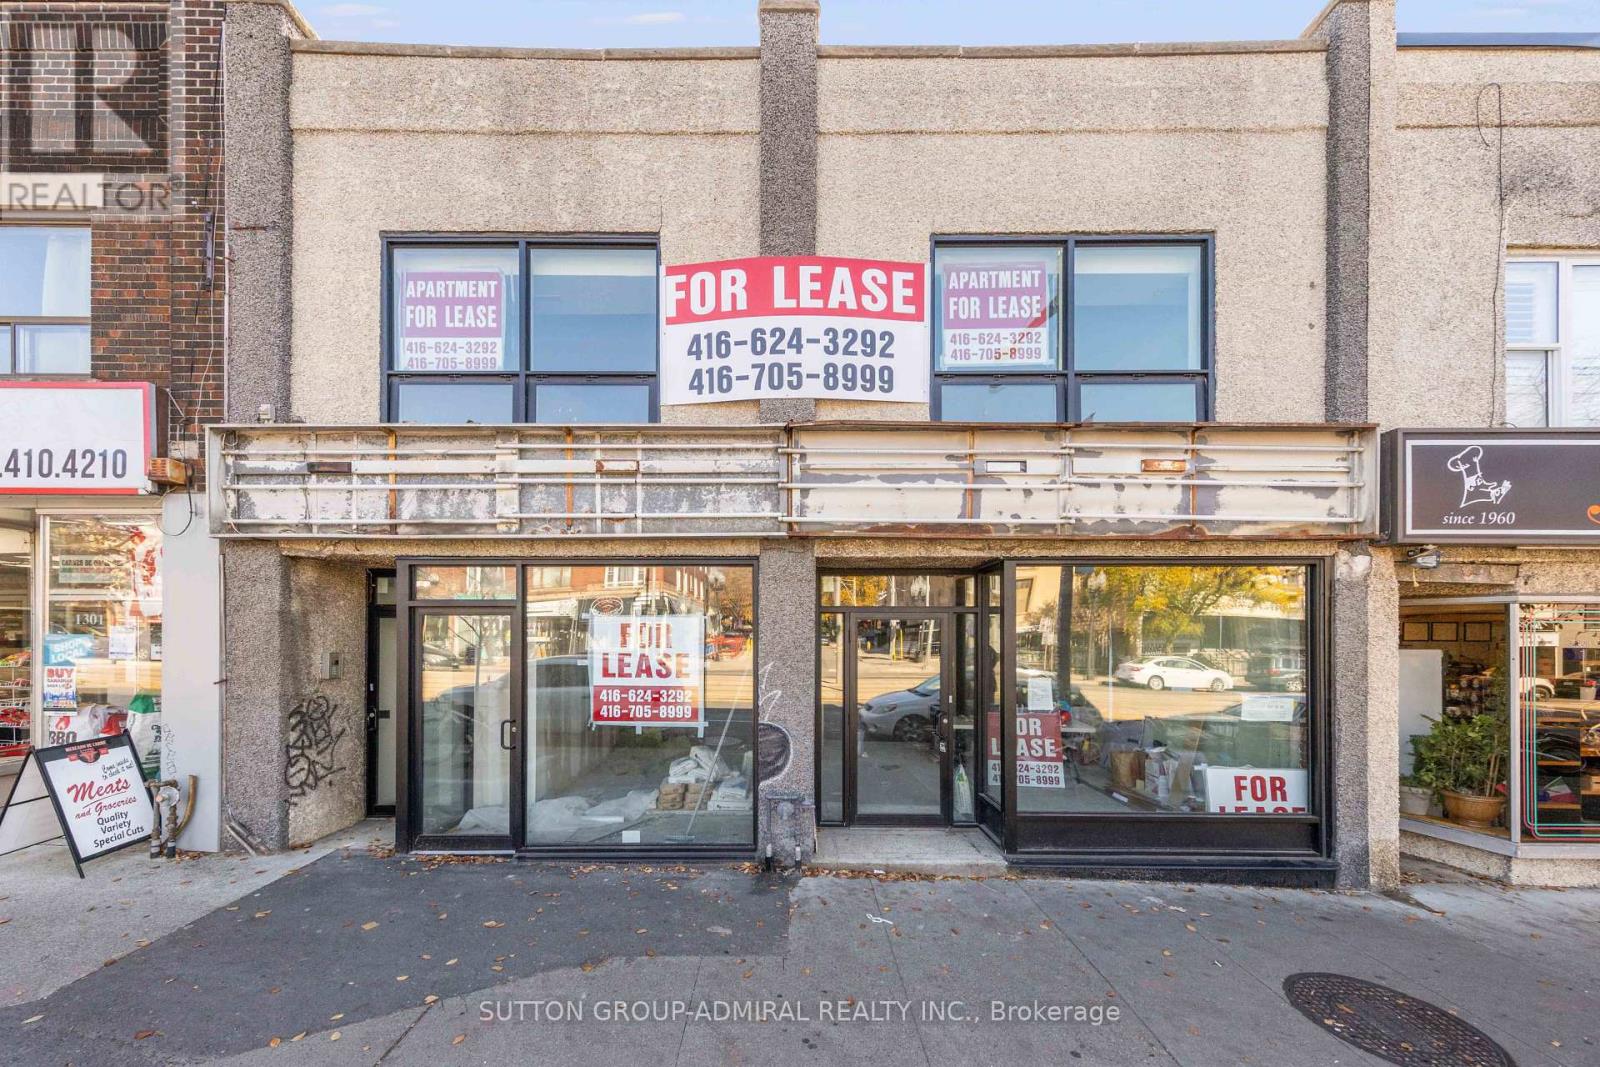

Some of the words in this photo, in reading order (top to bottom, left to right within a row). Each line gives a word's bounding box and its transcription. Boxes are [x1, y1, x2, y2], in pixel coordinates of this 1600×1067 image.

[406, 280, 497, 298] APARTMENT
[950, 270, 1041, 289] APARTMENT
[667, 268, 748, 318] FOR
[773, 265, 916, 314] LEASE
[405, 306, 437, 328] FOR
[445, 305, 497, 328] LEASE
[949, 297, 981, 320] FOR
[989, 295, 1041, 319] LEASE
[406, 341, 497, 354] 416-624-3292
[687, 326, 895, 361] 416-624-3292
[950, 332, 1041, 345] 416-624-3292
[407, 356, 497, 370] 416-705-8999
[951, 347, 1041, 361] 416-705-8999
[688, 362, 894, 395] 416-705-8999
[1442, 512, 1475, 524] since
[1478, 512, 1516, 524] 1960
[76, 614, 104, 624] 1301
[47, 668, 74, 678] BUY
[602, 653, 691, 679] LEASE
[599, 689, 692, 702] 416-624-3292
[600, 705, 691, 718] 416-705-8999
[1016, 717, 1042, 736] OR
[991, 738, 1057, 757] LASE
[67, 778, 131, 803] Meats
[1234, 775, 1288, 802] FOR
[75, 808, 92, 820] and
[95, 796, 137, 817] Groceries
[97, 811, 128, 826] Quality
[101, 820, 131, 834] Variety
[94, 830, 125, 848] Special
[126, 826, 144, 836] Cuts
